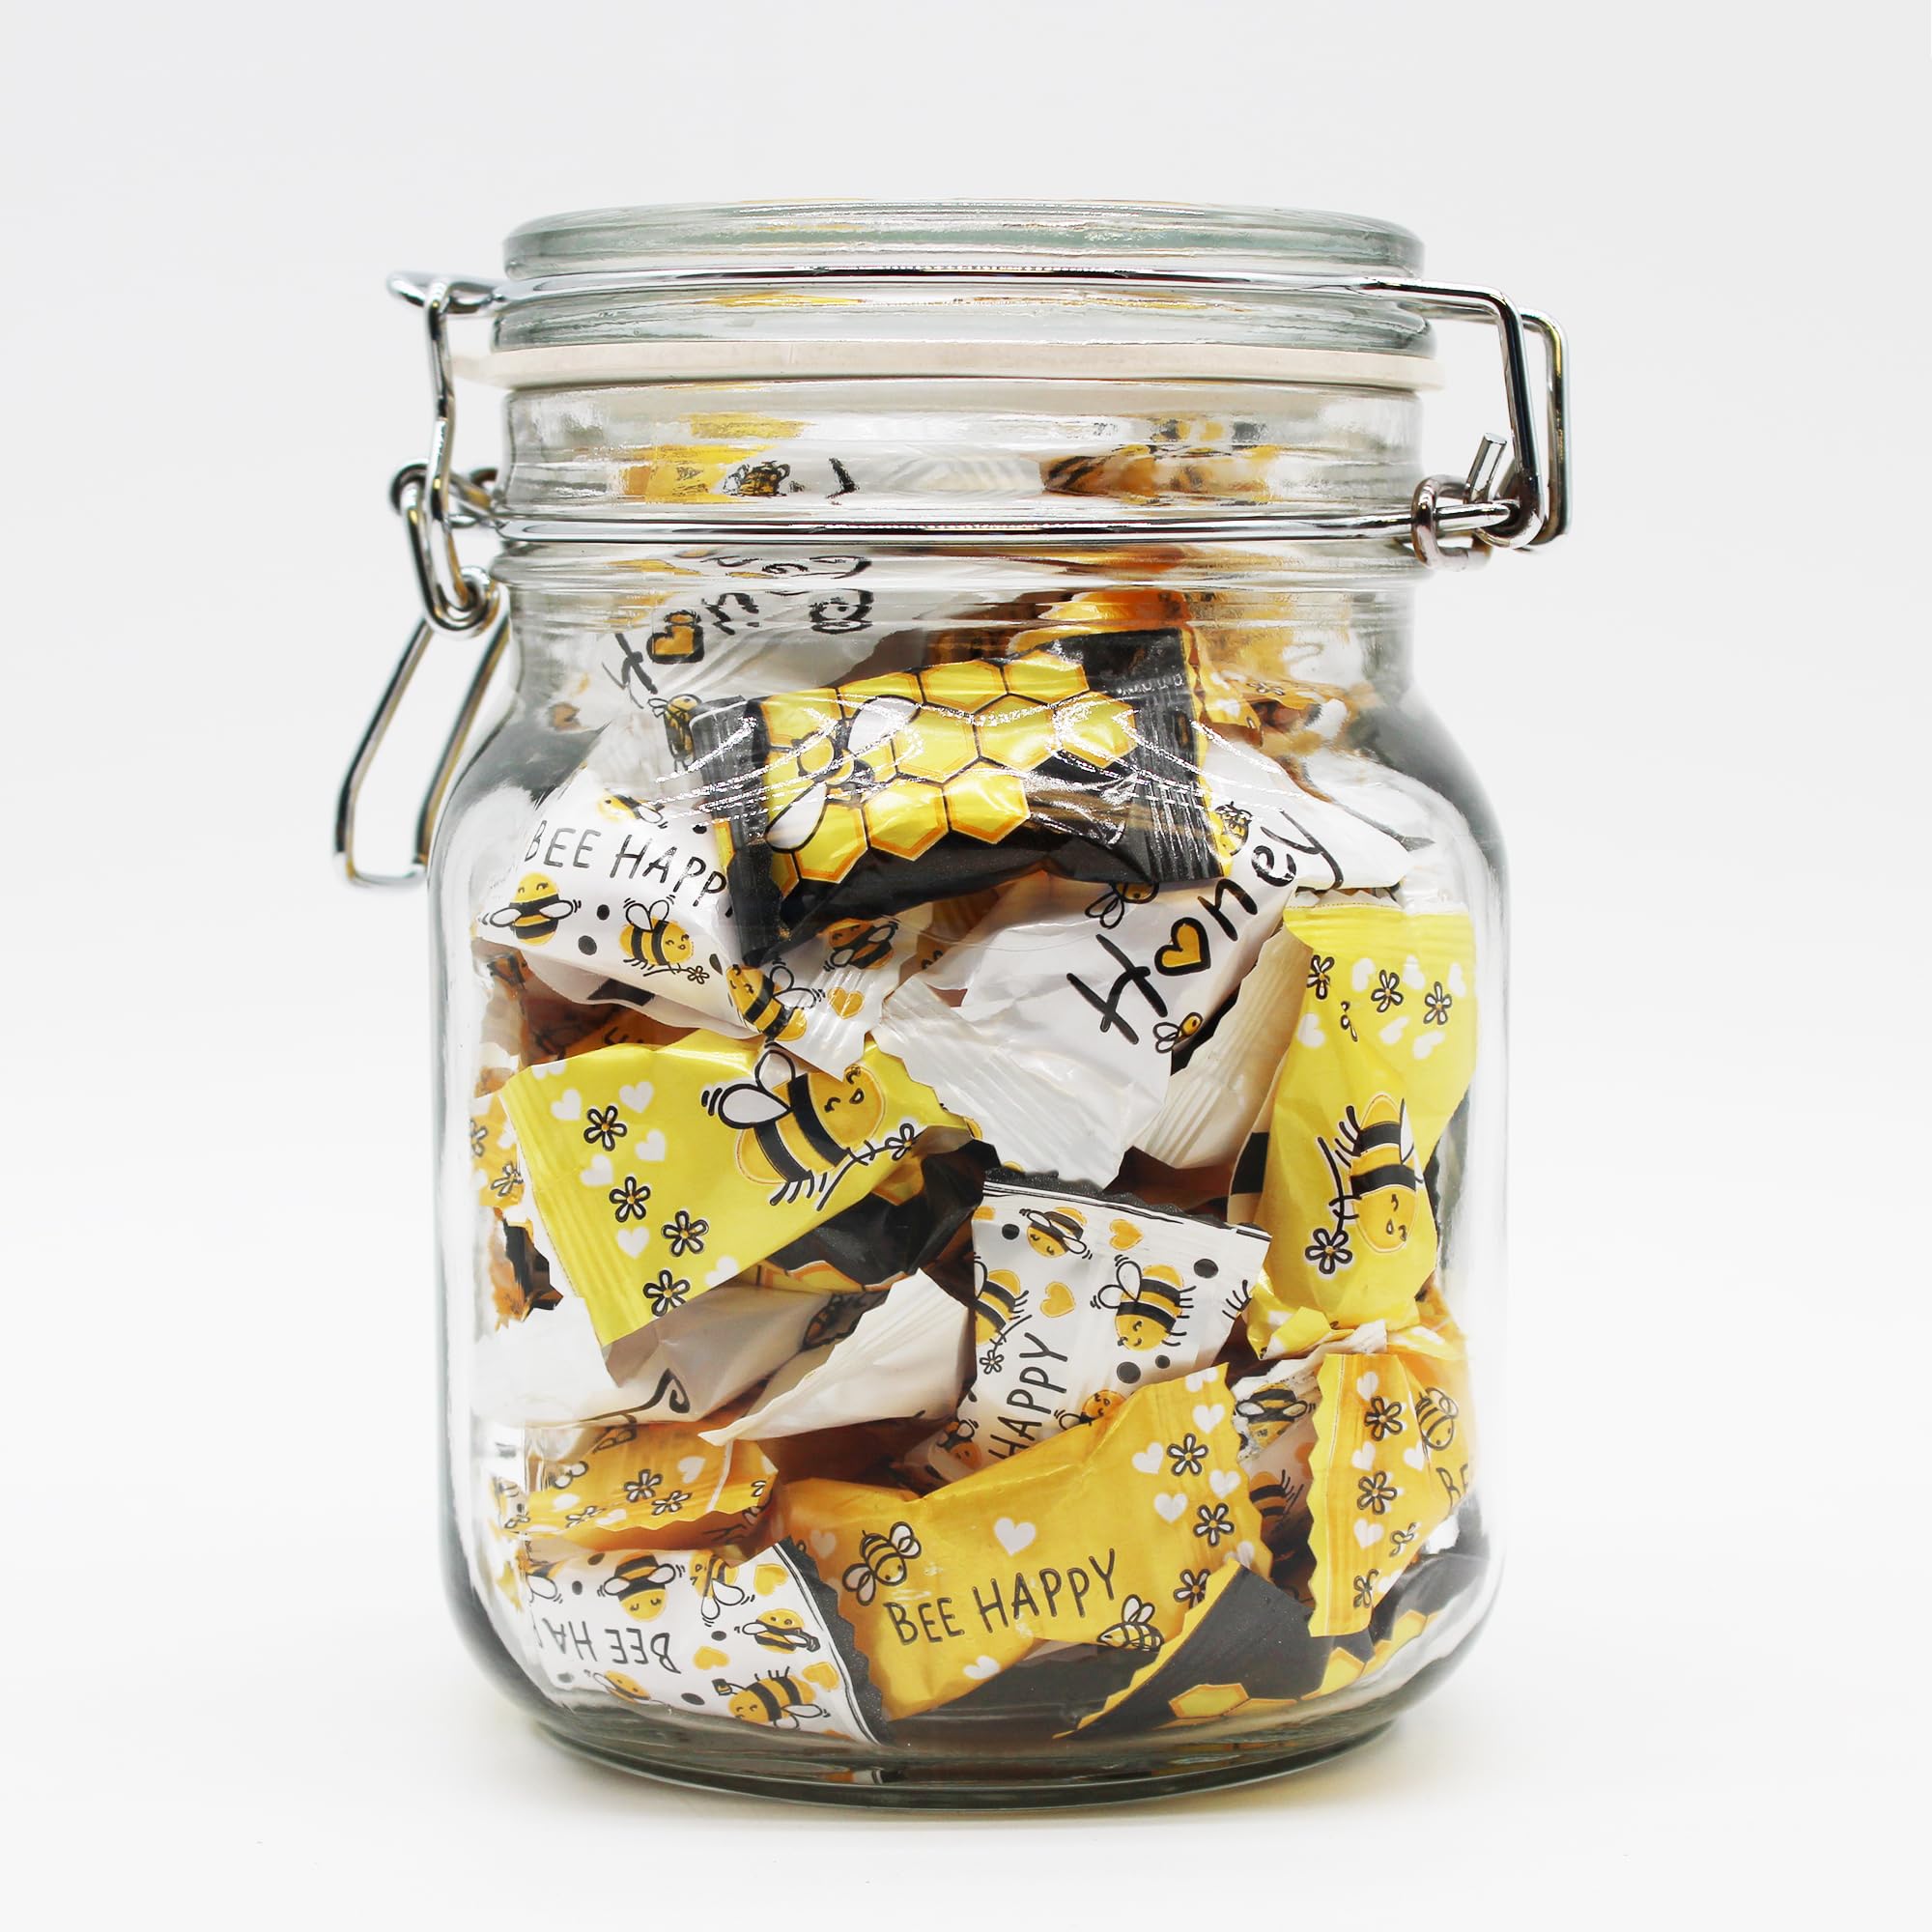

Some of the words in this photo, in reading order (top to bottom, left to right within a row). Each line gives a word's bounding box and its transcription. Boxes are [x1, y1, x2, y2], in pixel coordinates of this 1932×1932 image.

[525, 820, 602, 868] BEE
[610, 834, 733, 918] HAPP
[883, 1597, 965, 1646] BEE
[972, 1548, 1115, 1634] HAPPY
[604, 1627, 682, 1674] BEE
